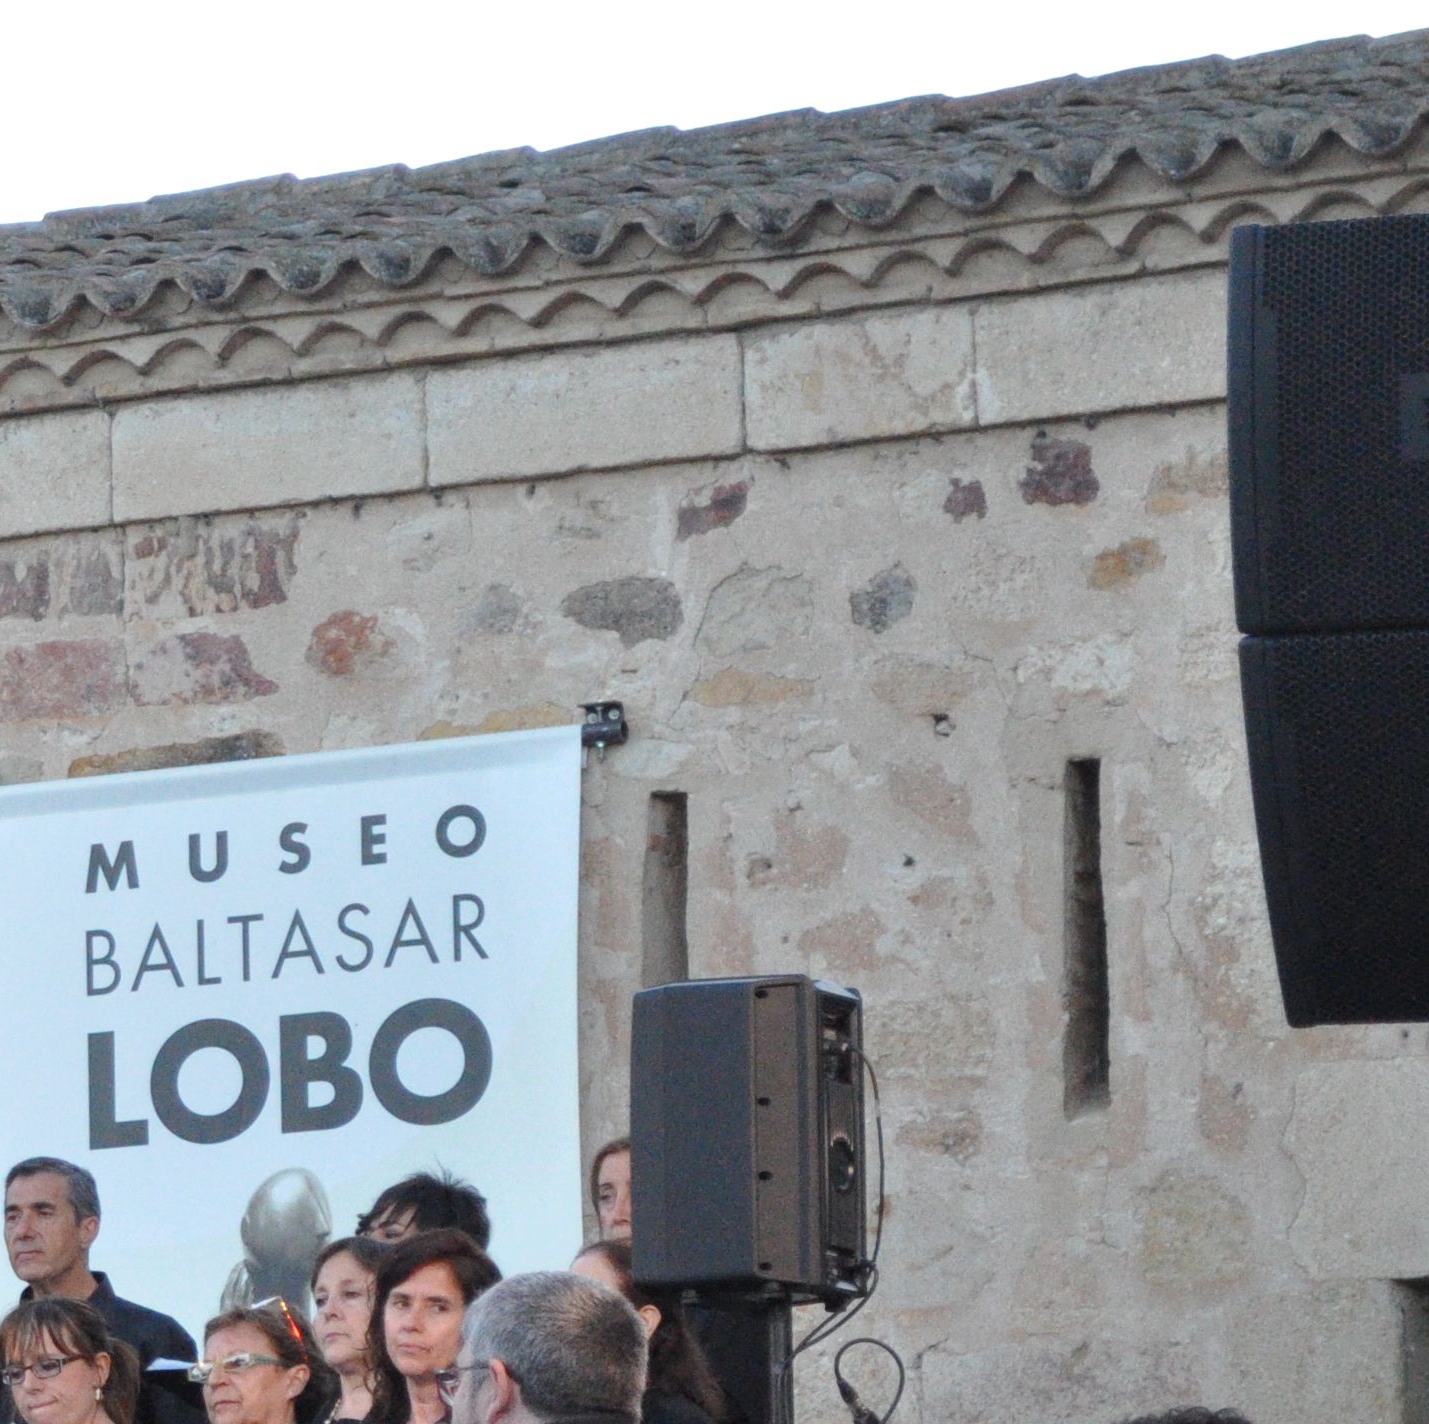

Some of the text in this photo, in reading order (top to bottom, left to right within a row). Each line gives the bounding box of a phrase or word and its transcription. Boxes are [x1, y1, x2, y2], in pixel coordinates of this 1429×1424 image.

[84, 804, 488, 894] MUSEO
[85, 893, 490, 997] BALTASAR
[86, 997, 493, 1150] LOBO
